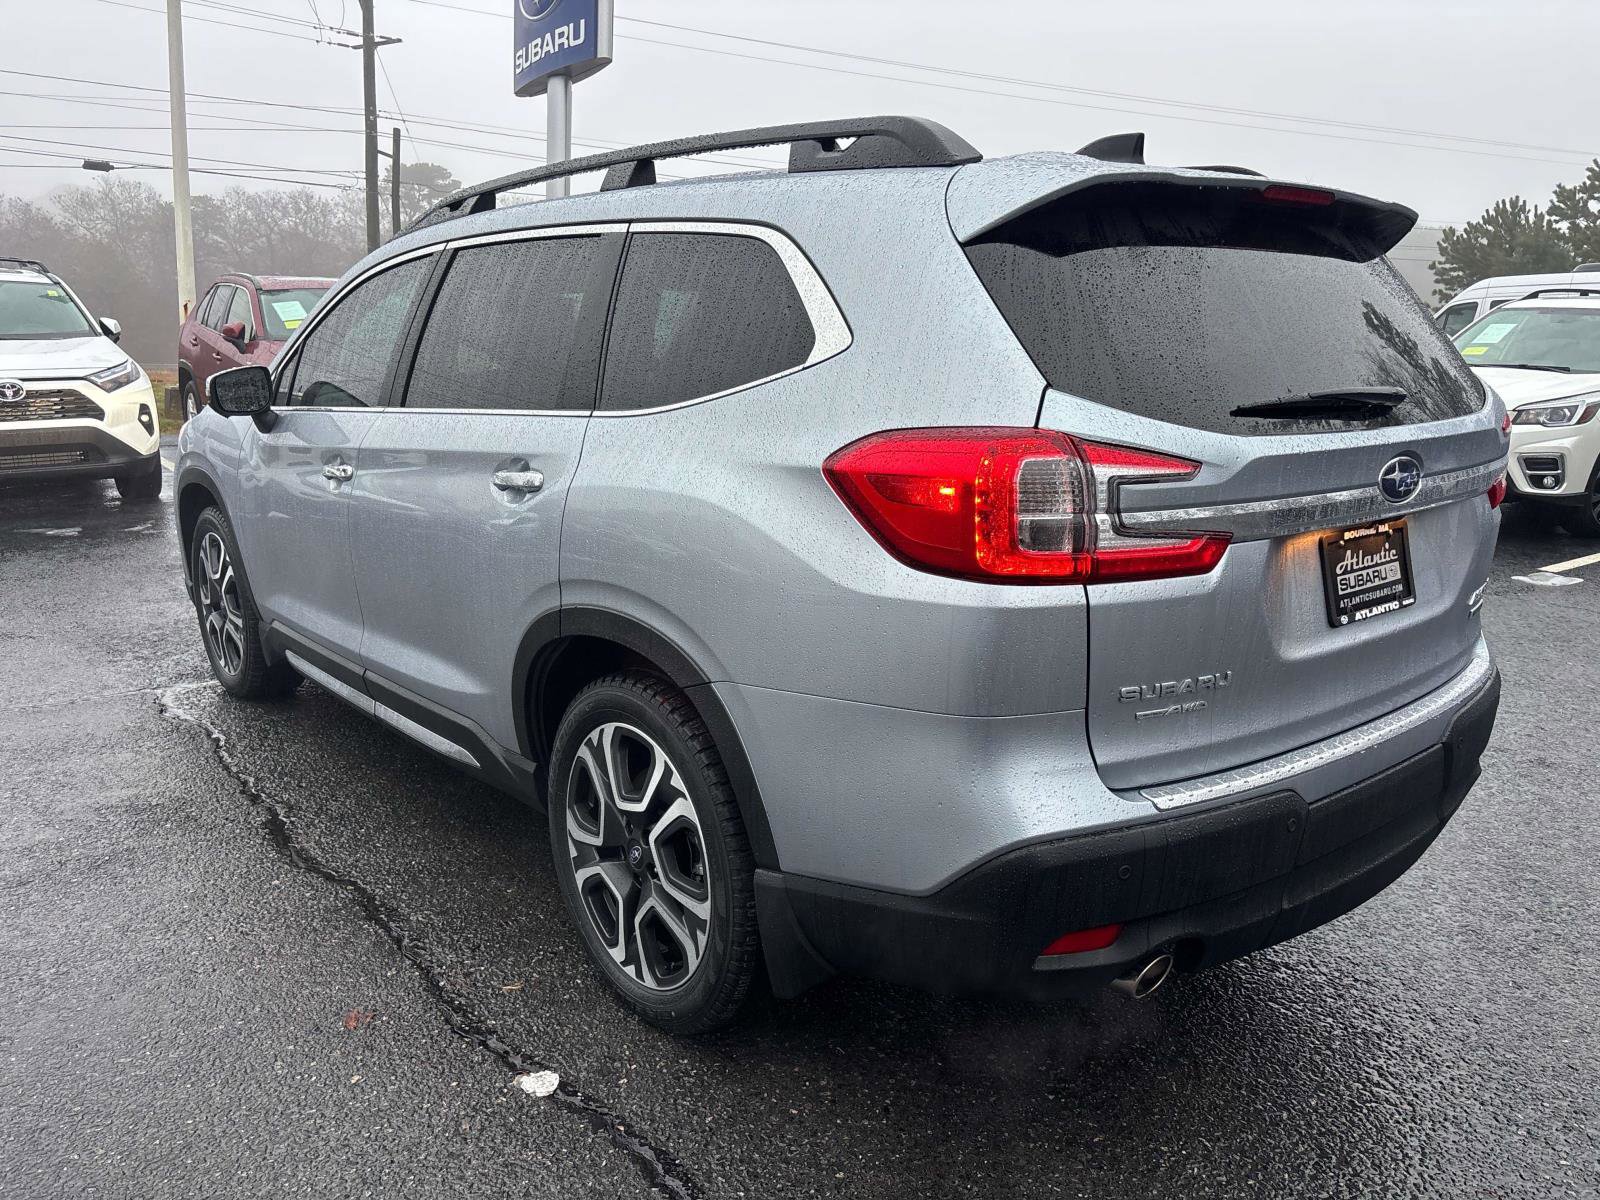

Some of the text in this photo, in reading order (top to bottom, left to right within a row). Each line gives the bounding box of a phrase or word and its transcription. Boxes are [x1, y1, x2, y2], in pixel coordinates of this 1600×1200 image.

[515, 19, 585, 75] SUBARU
[1378, 523, 1389, 533] MA
[1336, 542, 1398, 574] Atlantic
[1339, 567, 1388, 592] SUBARU
[1340, 584, 1403, 608] ATLANTICSUBARU.COM
[1355, 601, 1400, 621] ATLANTIC
[1119, 671, 1232, 702] SUBARU
